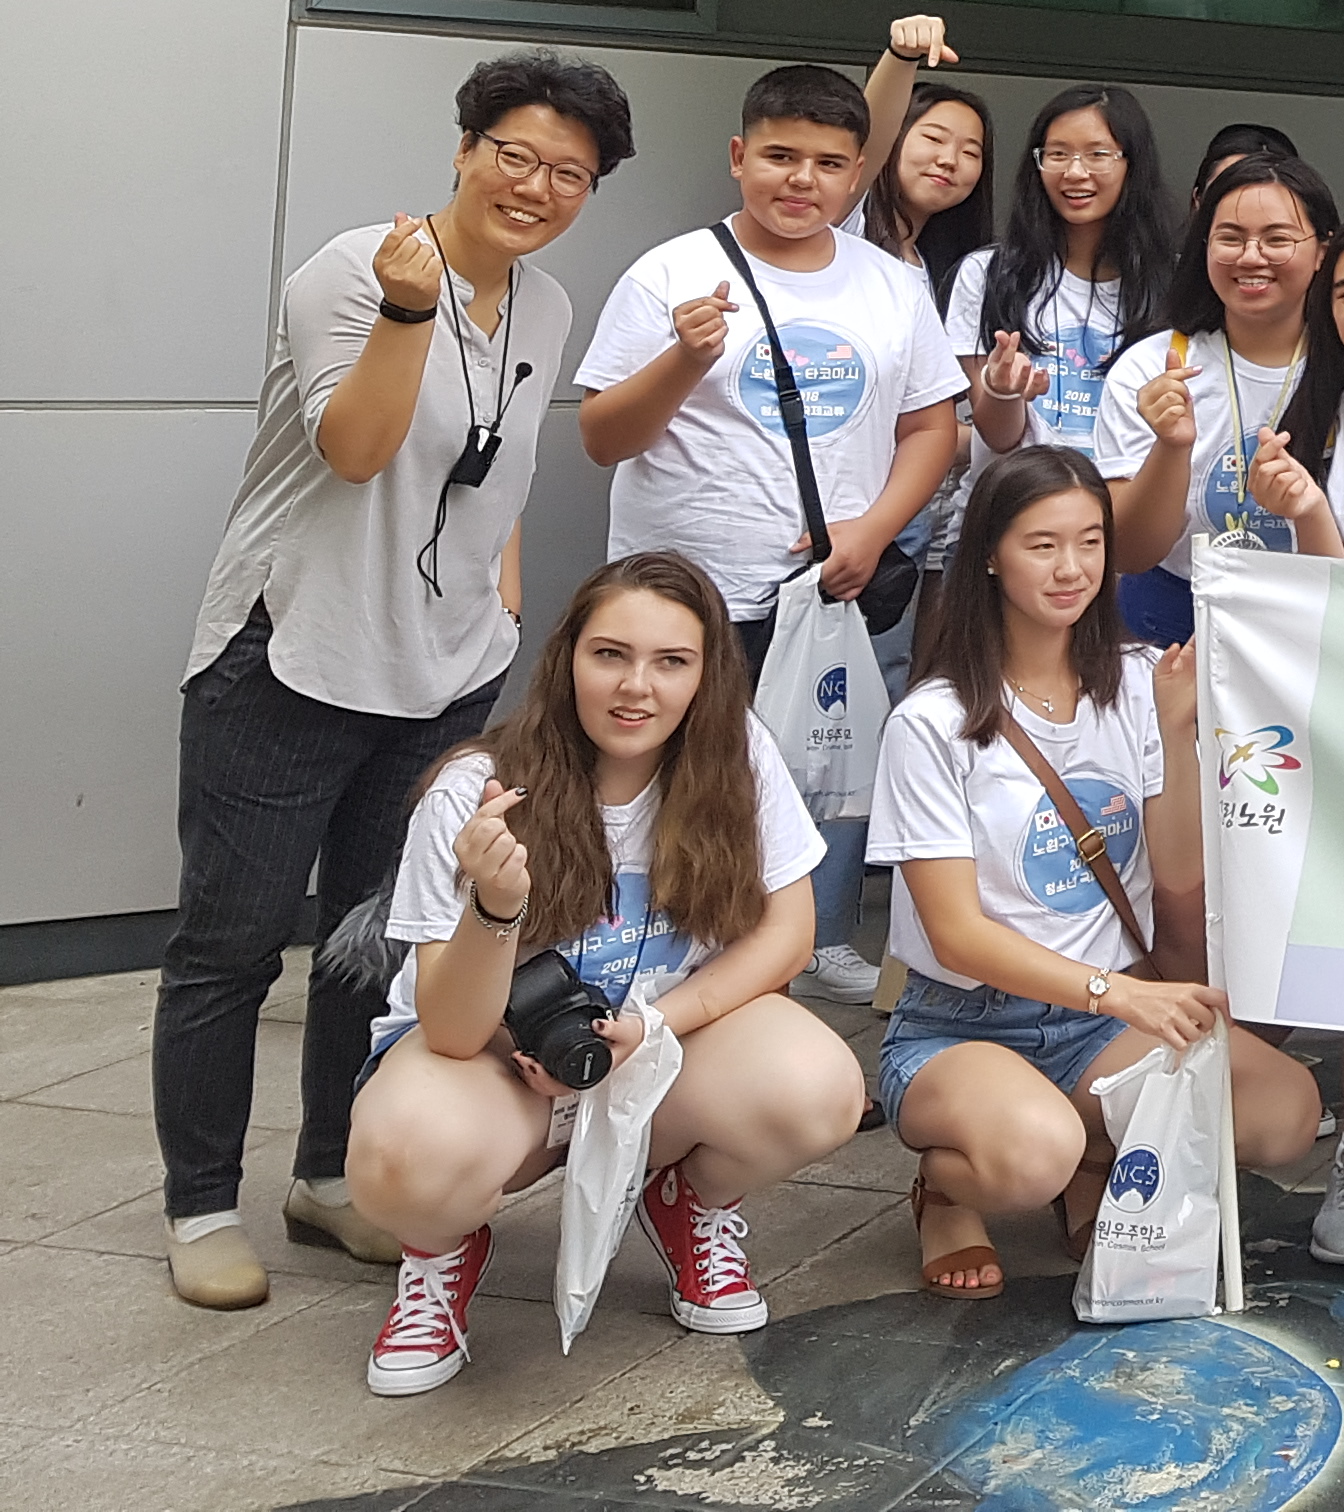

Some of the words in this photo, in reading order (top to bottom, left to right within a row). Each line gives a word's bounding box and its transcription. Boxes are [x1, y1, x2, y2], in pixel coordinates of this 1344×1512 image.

[805, 367, 859, 380] 타코마시
[1064, 390, 1091, 403] 2018
[820, 679, 846, 697] NC
[1032, 835, 1069, 857] 노원구
[1094, 817, 1133, 838] 코마시
[1045, 876, 1077, 896] 청소년
[601, 955, 637, 975] 2018
[1112, 1164, 1158, 1186] NCS
[1097, 1220, 1166, 1245] 원우주학교
